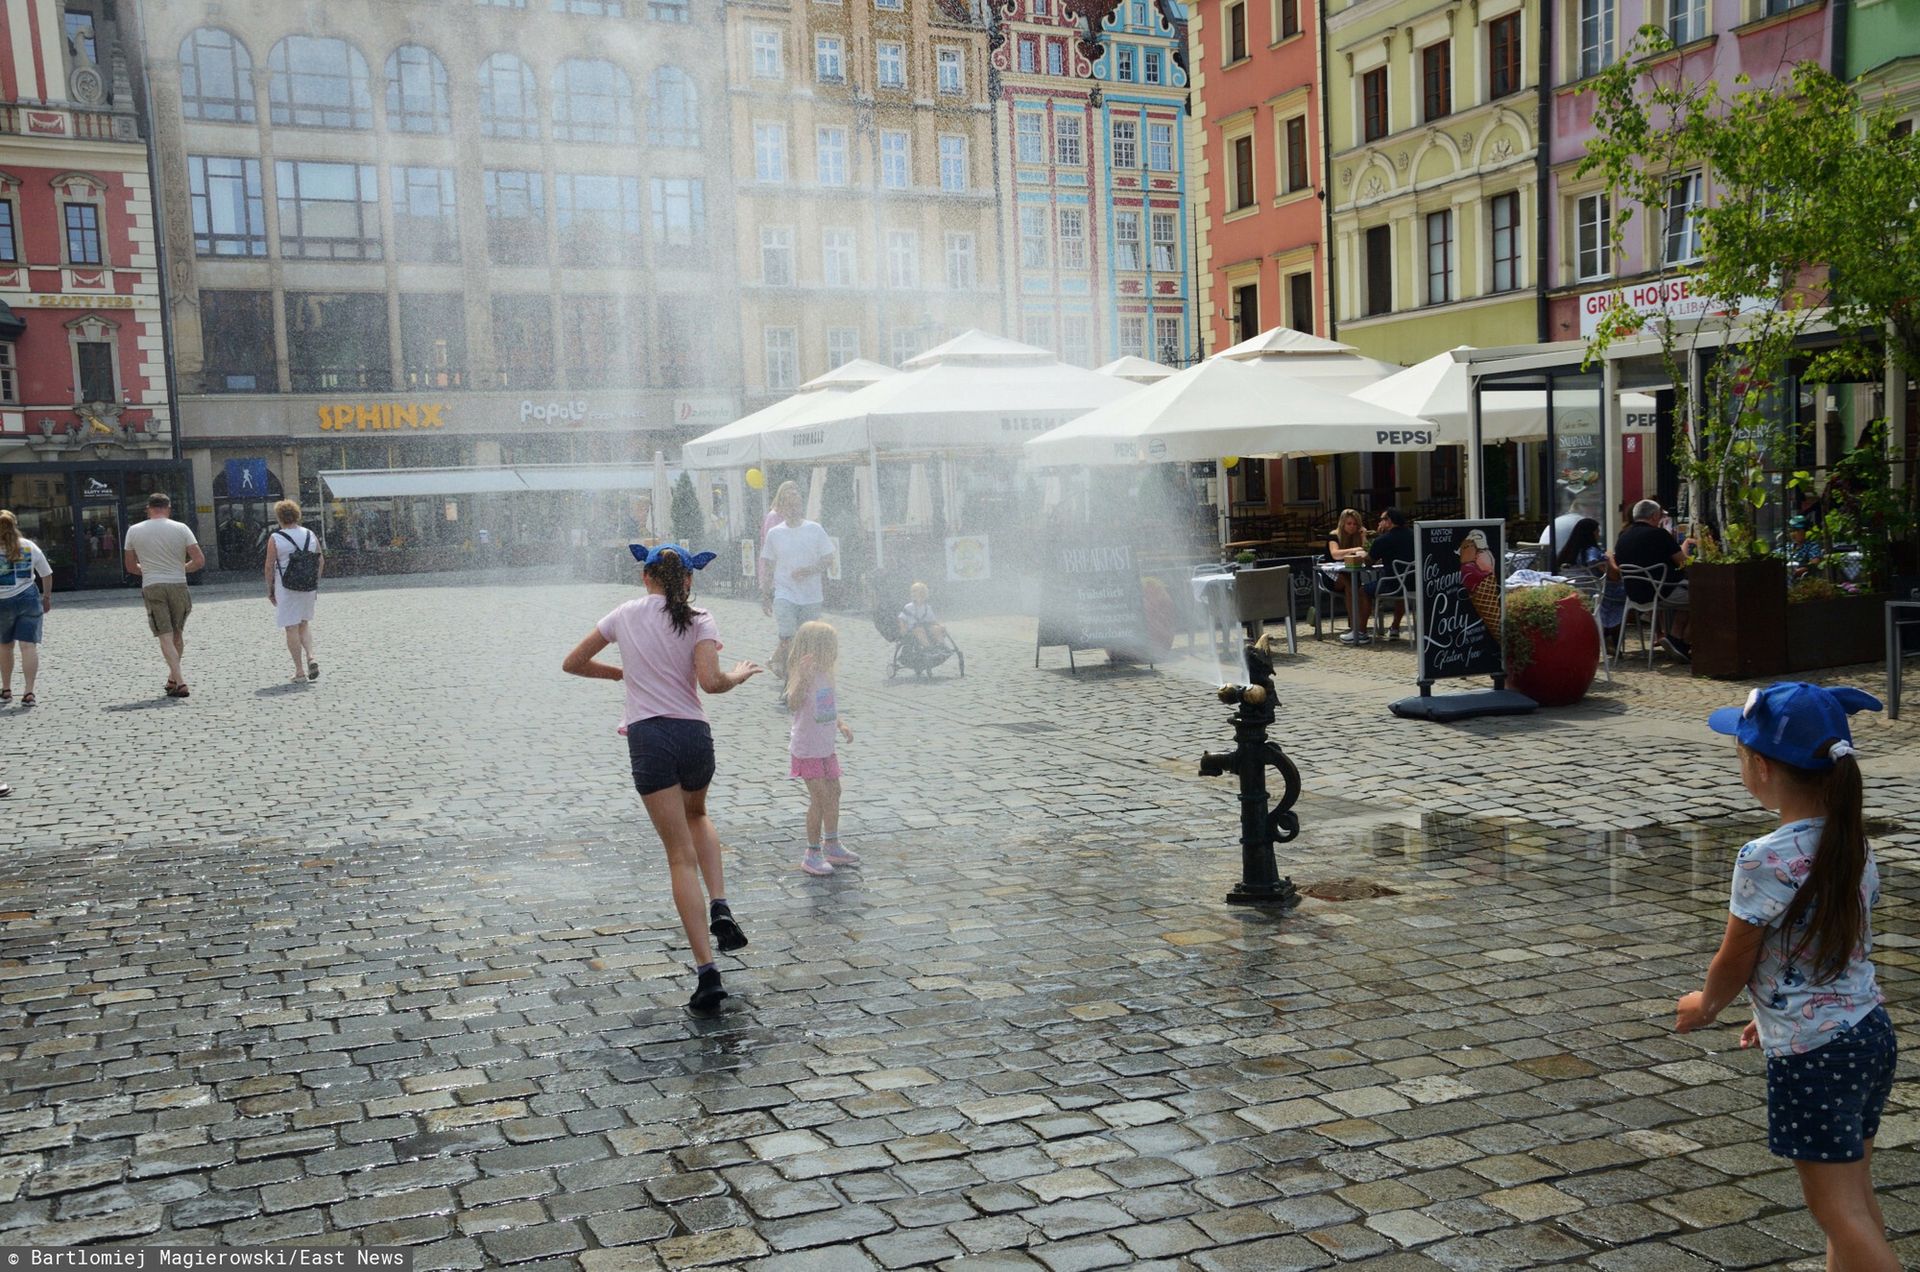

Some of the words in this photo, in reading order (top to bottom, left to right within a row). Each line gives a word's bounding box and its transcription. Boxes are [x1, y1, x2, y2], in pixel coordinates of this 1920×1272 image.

[1633, 281, 1690, 307] HOUSE
[96, 296, 133, 308] PIES
[318, 402, 445, 431] SPHINX
[1000, 416, 1072, 431] BIERHA
[1626, 413, 1657, 427] PEP
[1375, 430, 1432, 445] PEPSI
[1424, 592, 1483, 653] Lody
